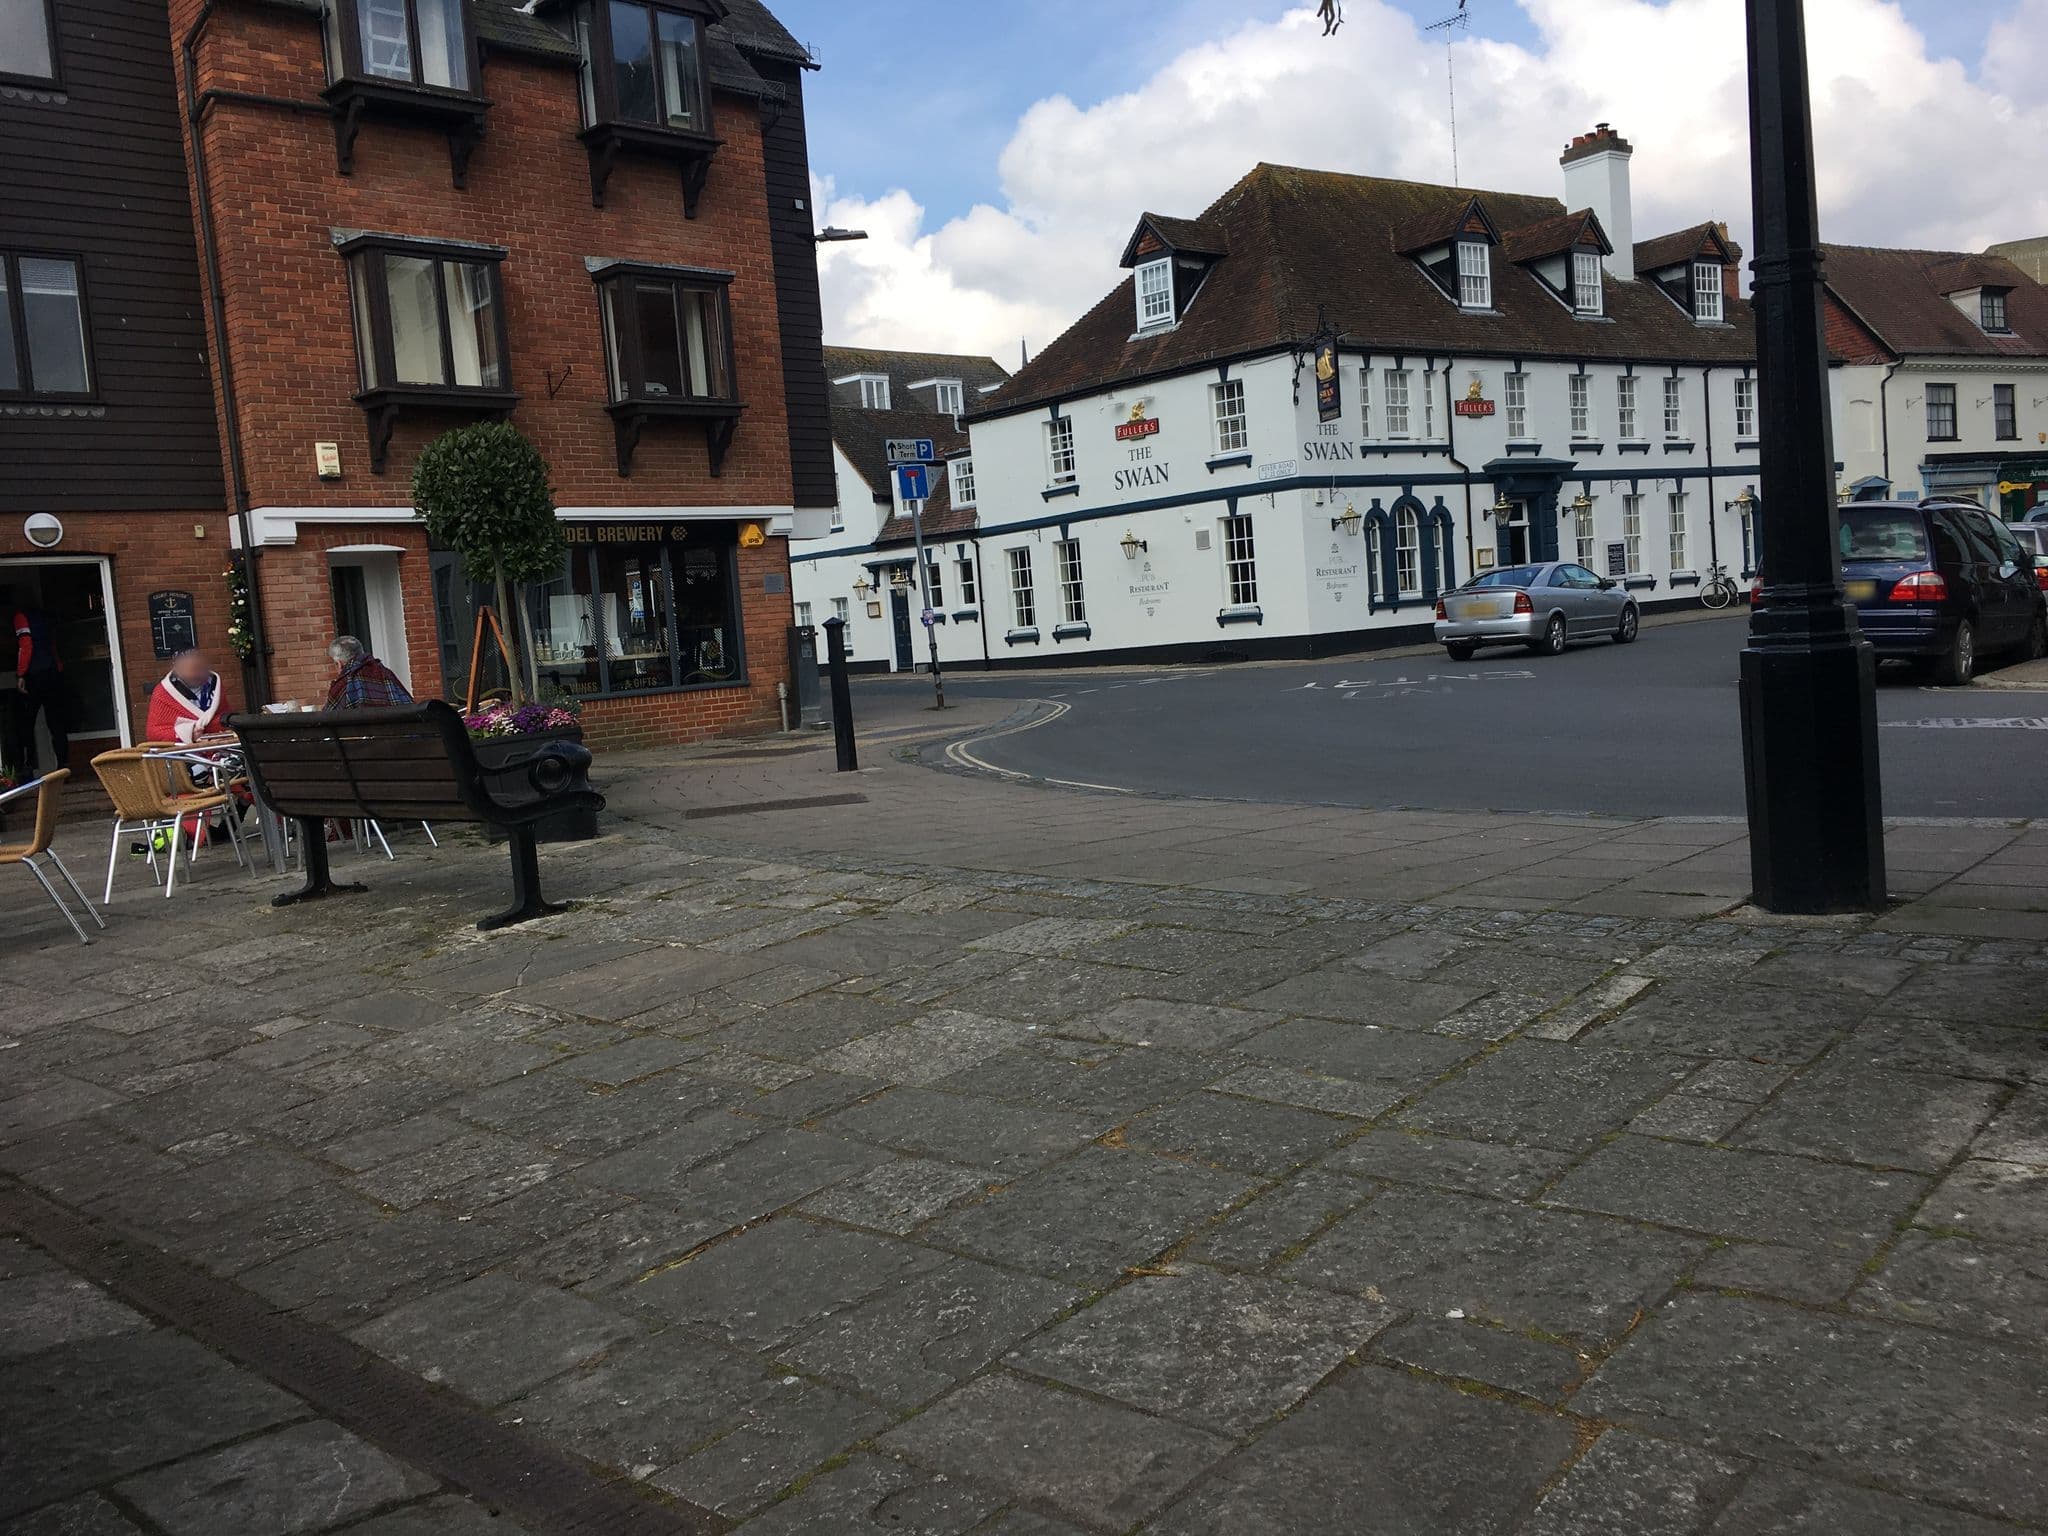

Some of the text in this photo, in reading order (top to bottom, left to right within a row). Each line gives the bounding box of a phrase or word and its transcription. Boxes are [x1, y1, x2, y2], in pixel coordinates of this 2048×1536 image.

[1317, 424, 1339, 436] THE
[1128, 446, 1152, 461] THE
[1303, 441, 1354, 461] SWAN
[1114, 462, 1169, 491] SWAN
[597, 526, 664, 542] BREWERY
[634, 677, 658, 689] GIFTS
